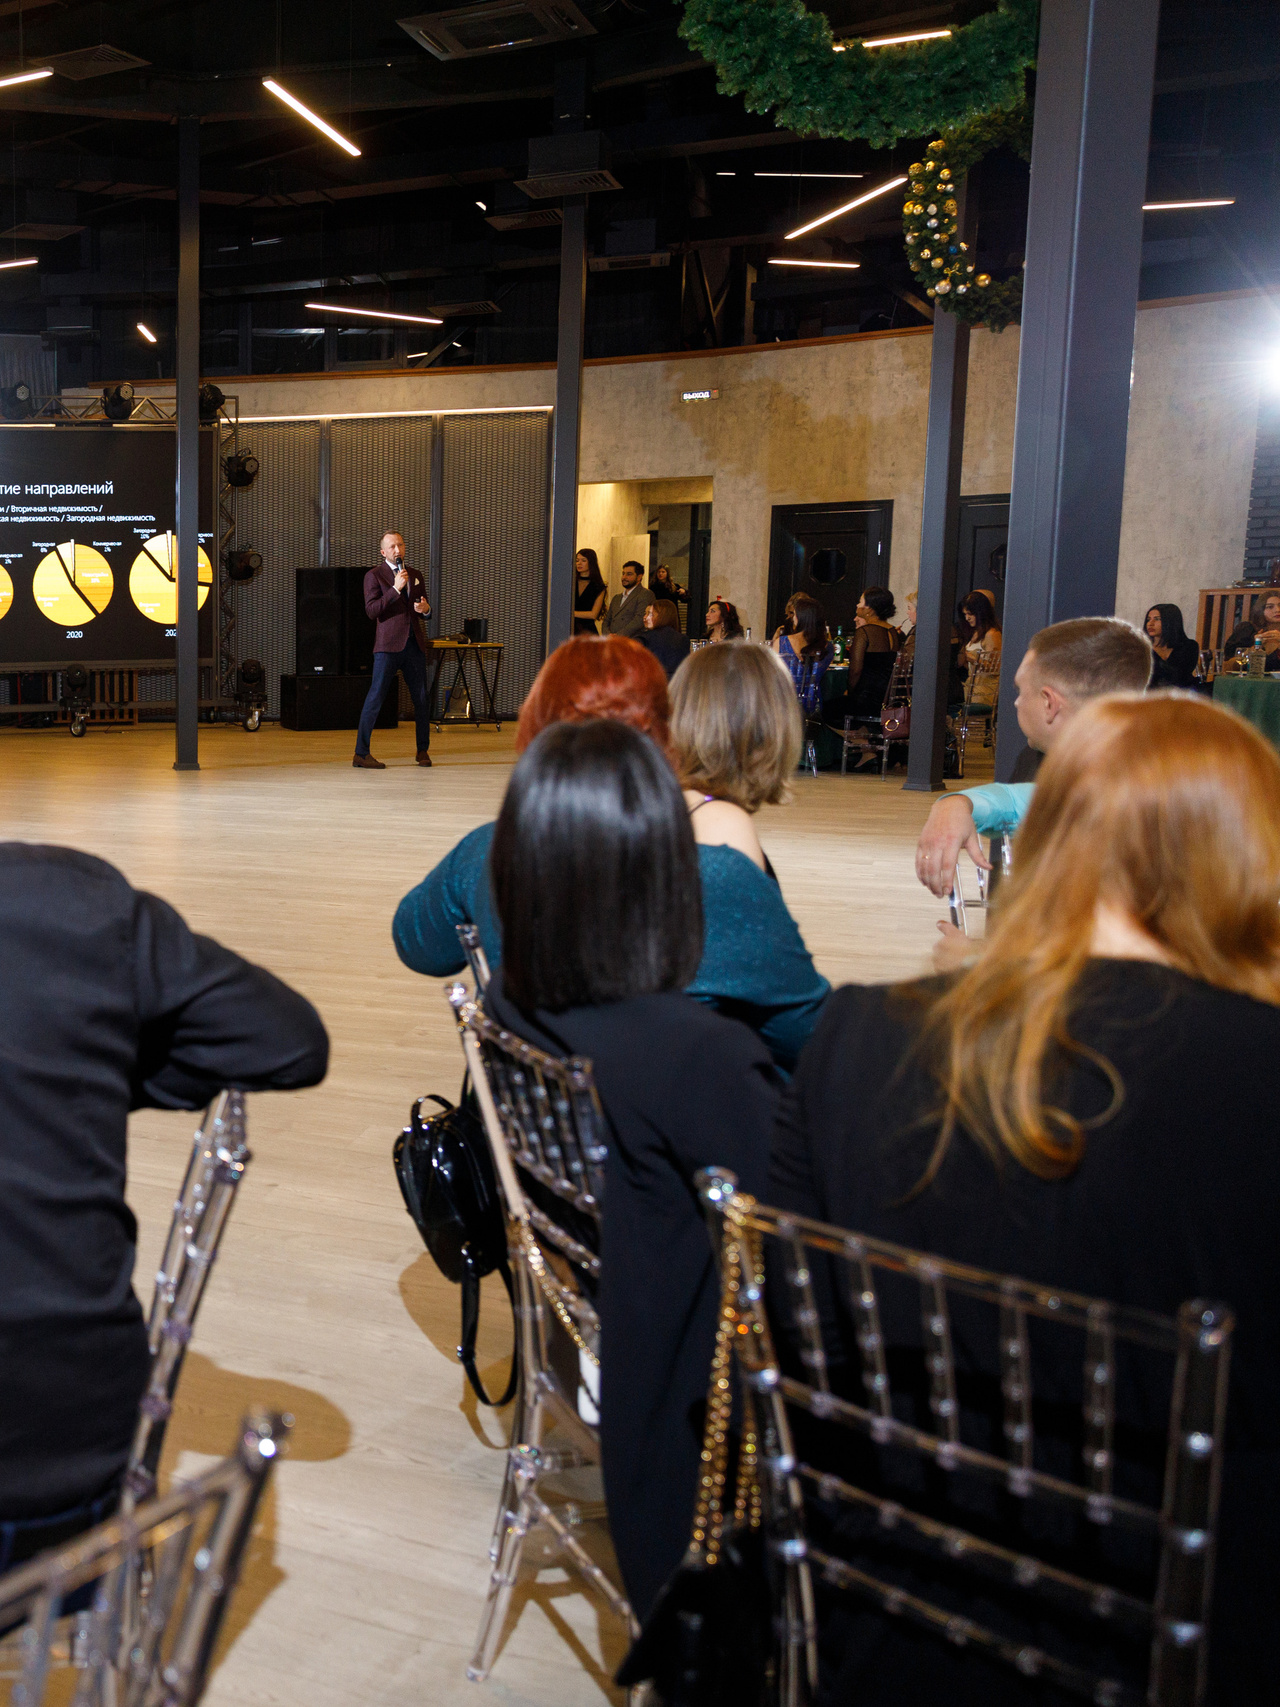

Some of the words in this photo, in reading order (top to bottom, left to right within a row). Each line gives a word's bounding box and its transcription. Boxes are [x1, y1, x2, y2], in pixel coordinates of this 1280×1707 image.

[683, 391, 710, 400] ВЫХОД
[24, 480, 114, 498] направлений
[10, 505, 48, 514] Вторичная
[48, 505, 98, 514] недвижимость
[66, 514, 106, 523] Загородная
[66, 631, 83, 639] 2020
[165, 629, 177, 637] 202
